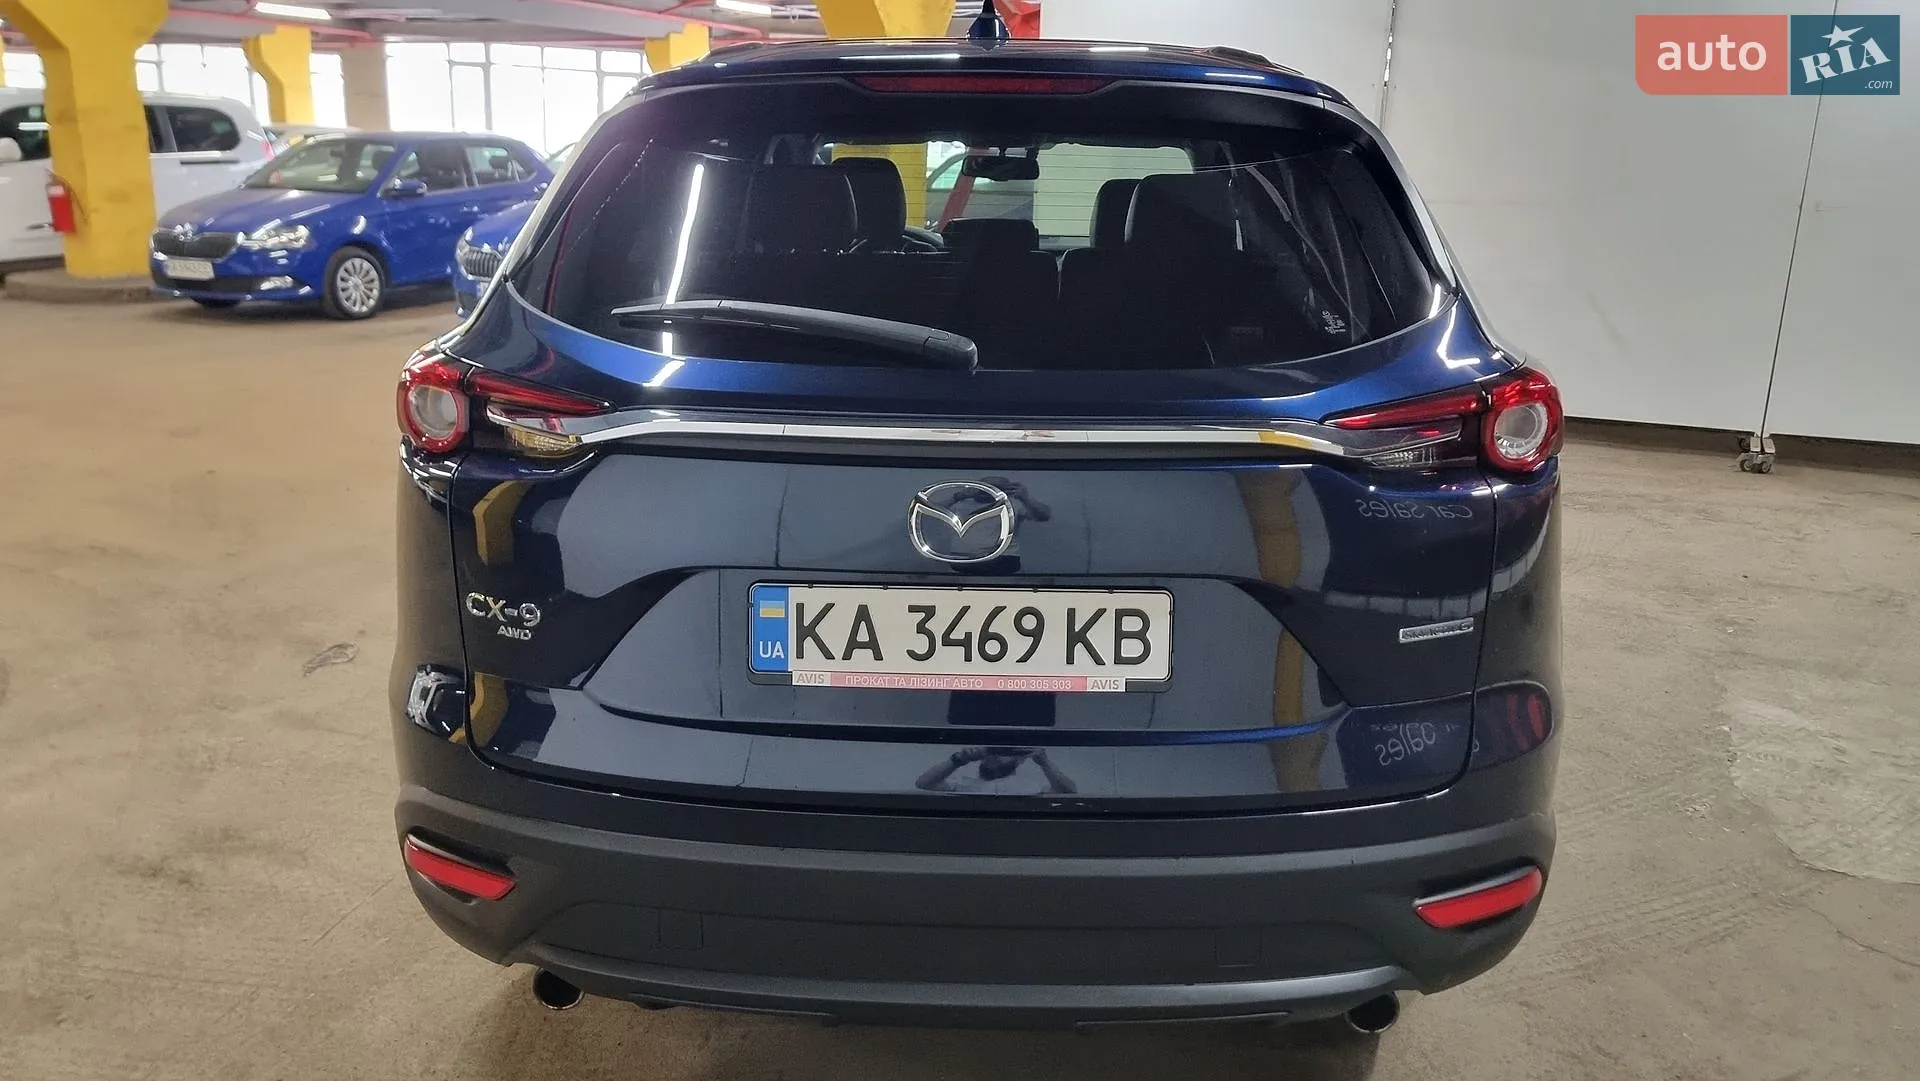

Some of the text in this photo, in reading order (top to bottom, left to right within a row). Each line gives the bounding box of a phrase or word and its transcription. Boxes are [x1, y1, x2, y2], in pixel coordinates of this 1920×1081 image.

[466, 592, 541, 627] CX-9
[497, 625, 532, 641] AWD
[795, 602, 1152, 666] KA 3469 KB
[759, 641, 785, 660] UA
[796, 673, 825, 685] AVIS
[845, 676, 889, 688] ПРОКАТ
[894, 678, 908, 688] ТА
[909, 678, 950, 689] ЛІЗИНГ
[953, 679, 984, 690] АВТО
[997, 679, 1005, 689] 0
[1007, 679, 1027, 690] 800
[1090, 680, 1120, 691] AVIS
